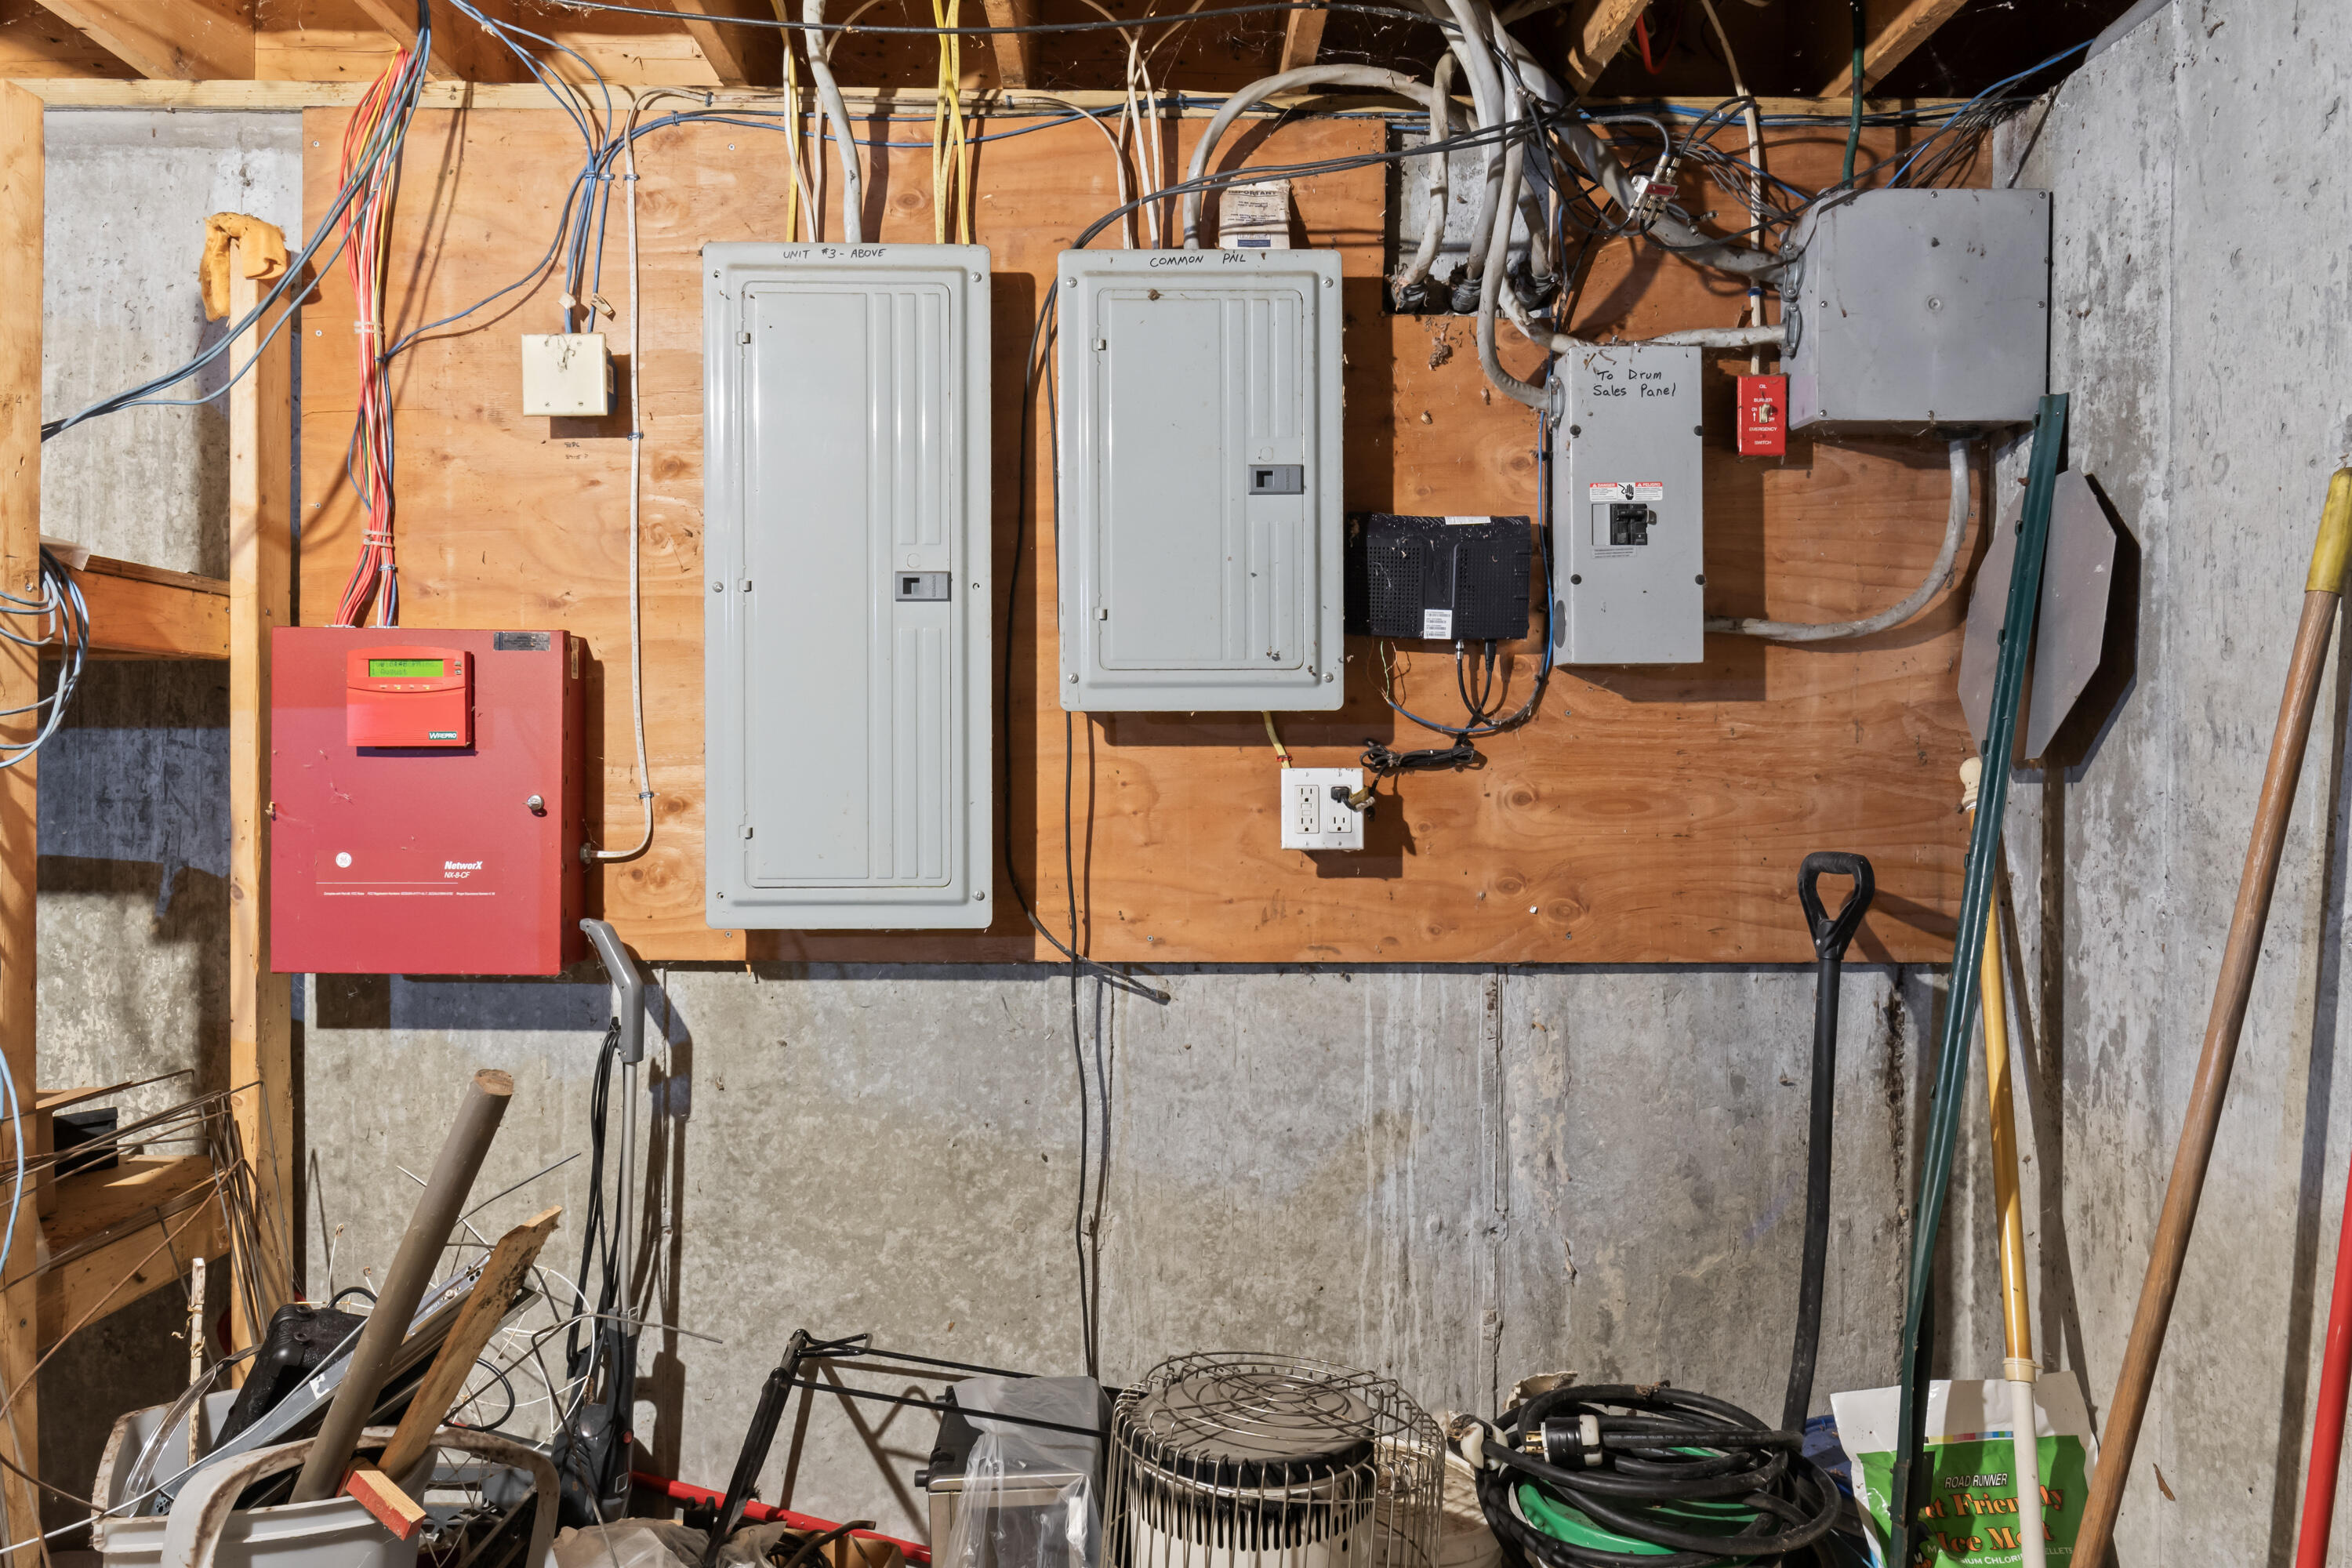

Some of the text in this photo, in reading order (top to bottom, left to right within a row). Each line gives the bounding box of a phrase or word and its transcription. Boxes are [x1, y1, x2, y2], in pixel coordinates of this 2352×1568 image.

[782, 250, 811, 260] UNIT
[851, 248, 887, 259] ABOVE
[1149, 252, 1247, 267] COMMON PNL
[1596, 368, 1662, 381] To Drum
[1593, 382, 1676, 397] Sales Panel
[445, 861, 483, 869] NetworX
[1944, 1473, 2008, 1489] ROAD RUNNER
[1925, 1485, 2065, 1519] et Frienly
[1984, 1554, 2024, 1565] CHLORI
[2045, 1547, 2074, 1555] ELLETS
